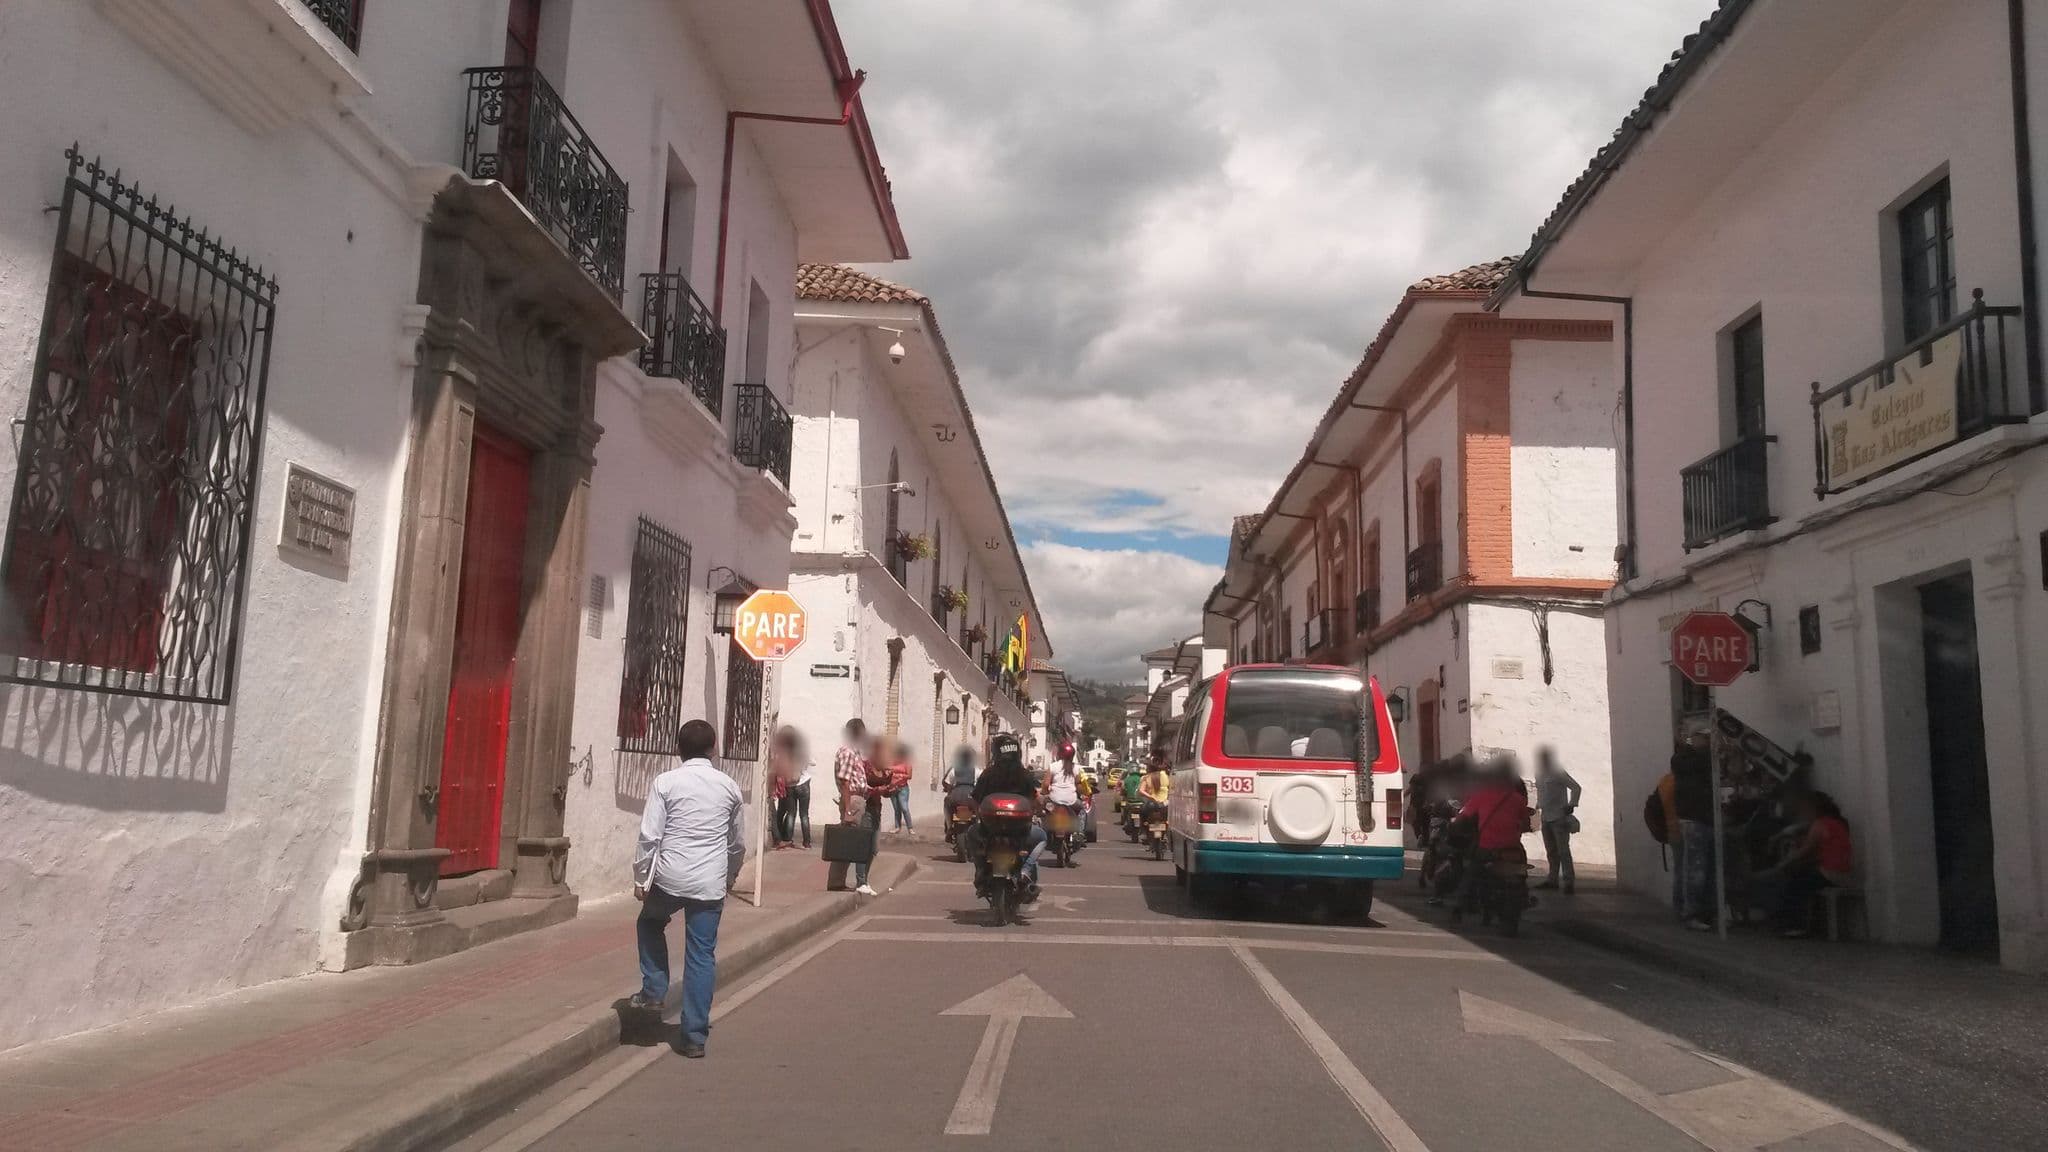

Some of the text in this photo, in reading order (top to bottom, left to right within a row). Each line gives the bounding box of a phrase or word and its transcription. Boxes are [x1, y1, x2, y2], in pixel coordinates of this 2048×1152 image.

[1871, 391, 1925, 429] Colegio
[741, 611, 801, 639] PARE
[1679, 634, 1743, 663] PARE
[1222, 777, 1253, 793] 303
